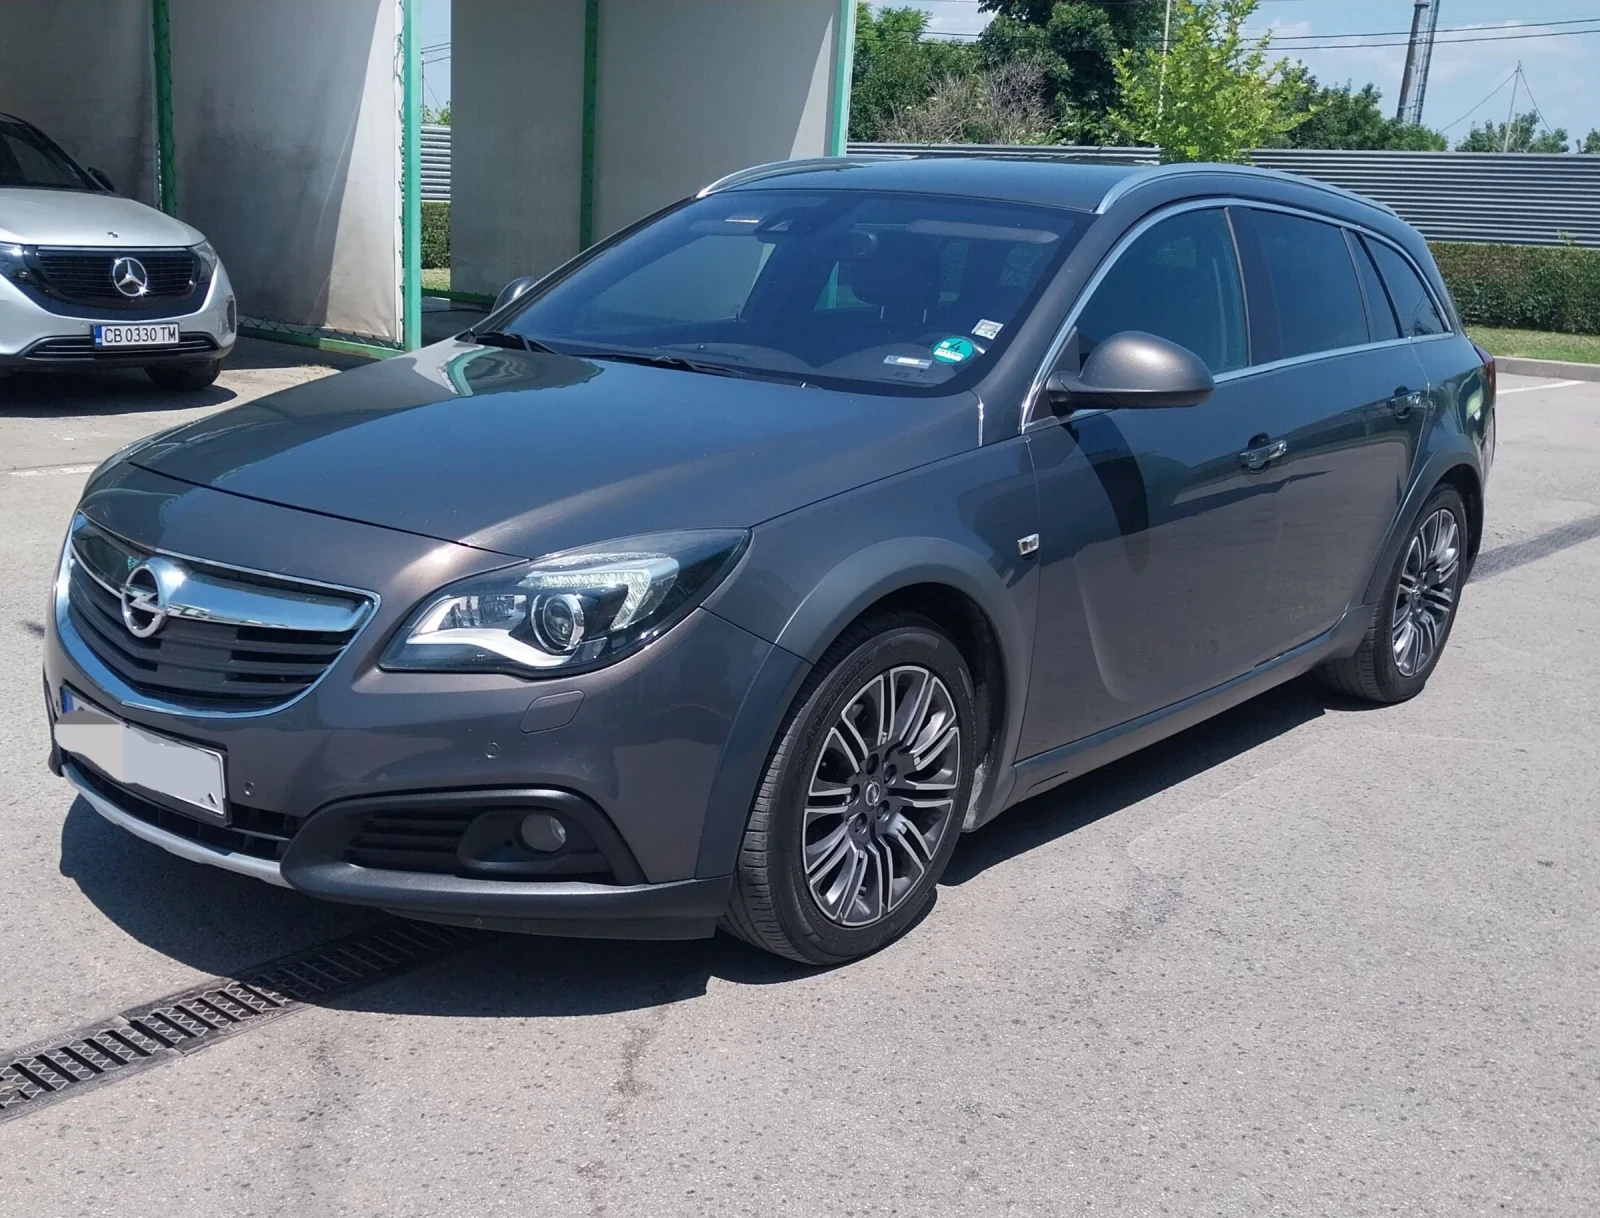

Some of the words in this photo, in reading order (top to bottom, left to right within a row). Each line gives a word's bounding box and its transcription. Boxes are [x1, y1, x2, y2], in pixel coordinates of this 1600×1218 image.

[104, 328, 123, 343] CB
[125, 327, 157, 342] 0330
[160, 326, 176, 342] TM
